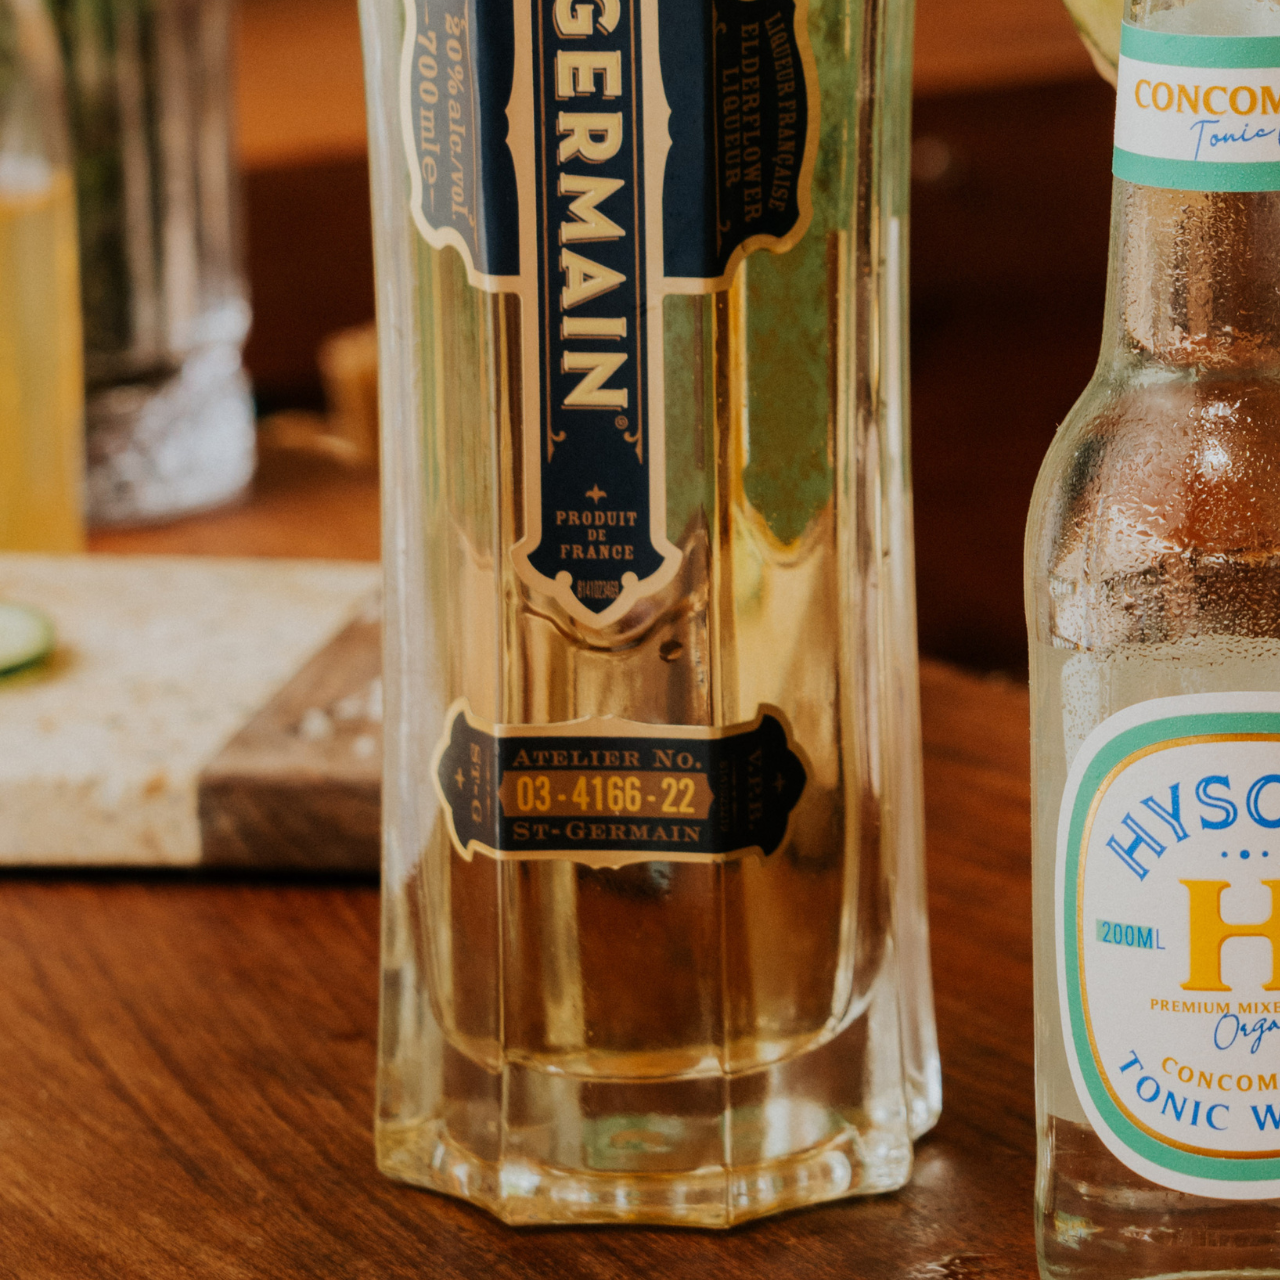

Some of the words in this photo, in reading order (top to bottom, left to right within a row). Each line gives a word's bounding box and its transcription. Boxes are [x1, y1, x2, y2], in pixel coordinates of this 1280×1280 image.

[763, 10, 796, 97] LIQUEUR
[722, 66, 742, 187] LIQUEUR
[740, 22, 763, 222] ELDERFLOWER
[1190, 119, 1277, 161] Tonic
[767, 99, 797, 212] FRANÇAISE
[555, 510, 638, 527] PRODUIT
[587, 528, 606, 542] DE
[560, 544, 635, 560] FRANCE
[512, 749, 641, 768] ATELIER
[1101, 920, 1166, 951] 200ML
[1150, 998, 1231, 1015] PREMIUM
[1118, 1049, 1231, 1132] TONIC
